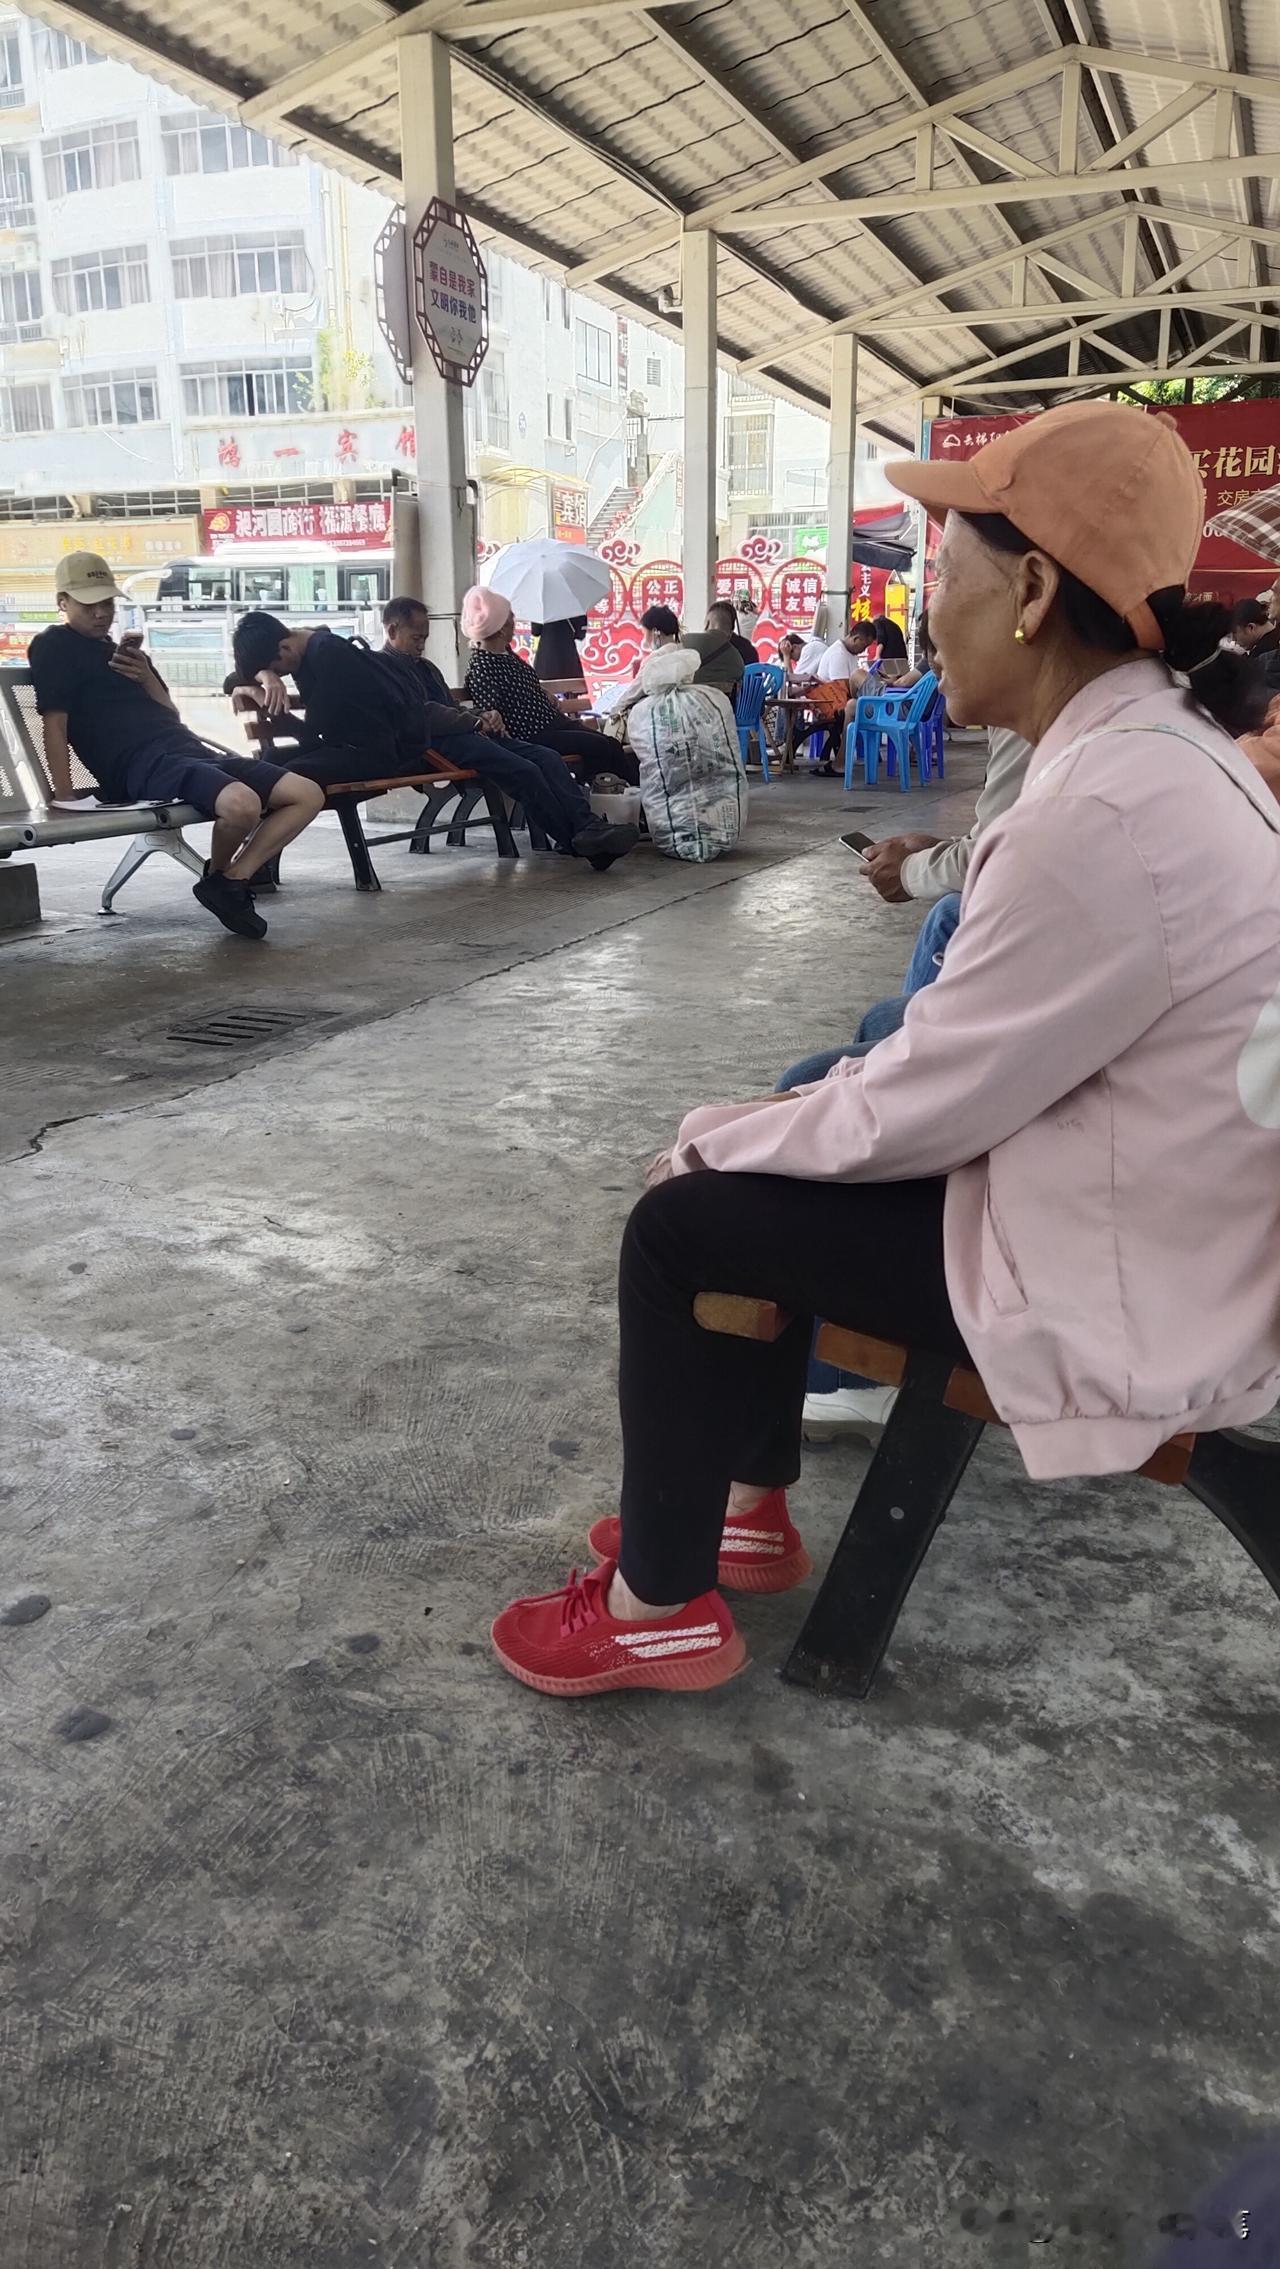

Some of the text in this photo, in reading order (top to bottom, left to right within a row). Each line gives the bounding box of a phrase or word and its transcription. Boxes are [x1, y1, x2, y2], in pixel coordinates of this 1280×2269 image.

[431, 288, 477, 324] 文明你我他
[647, 579, 679, 595] 公正
[785, 577, 818, 594] 诚信
[785, 596, 818, 612] 友善
